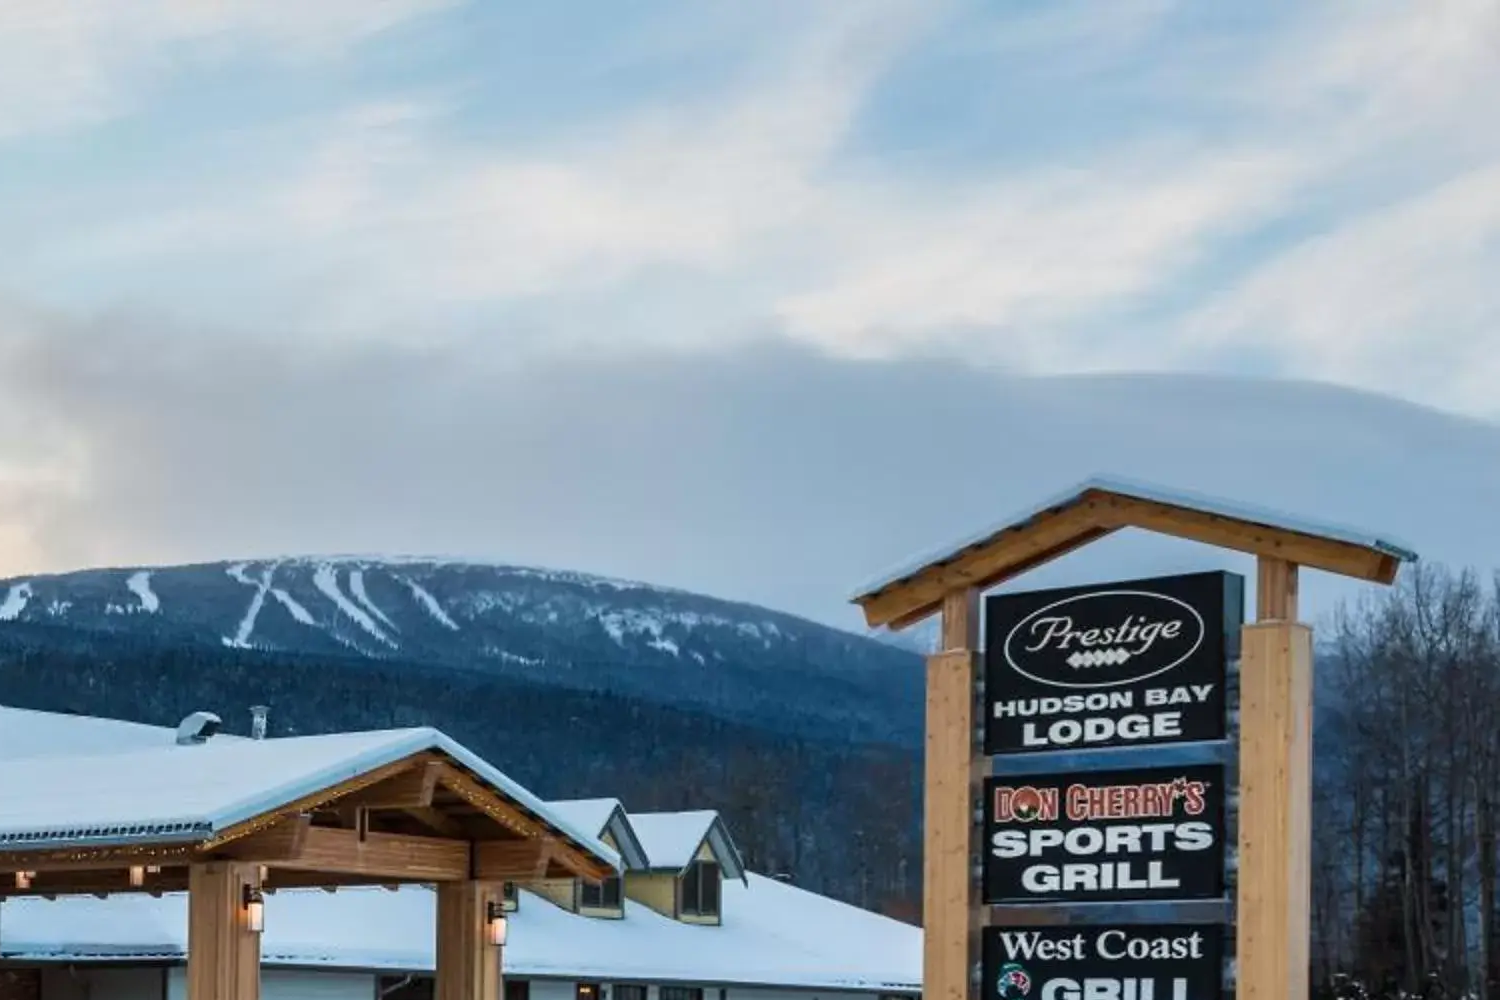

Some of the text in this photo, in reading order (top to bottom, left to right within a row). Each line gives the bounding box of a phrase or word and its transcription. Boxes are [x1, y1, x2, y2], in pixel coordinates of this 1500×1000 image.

[1025, 614, 1183, 655] Prestige
[993, 684, 1214, 718] HUDSON BAY
[1023, 712, 1182, 746] LODGE
[994, 778, 1205, 823] DON CHERRY'S
[991, 821, 1214, 858] SPORTS
[1021, 861, 1180, 892] GRILL
[1000, 930, 1204, 960] West Coast
